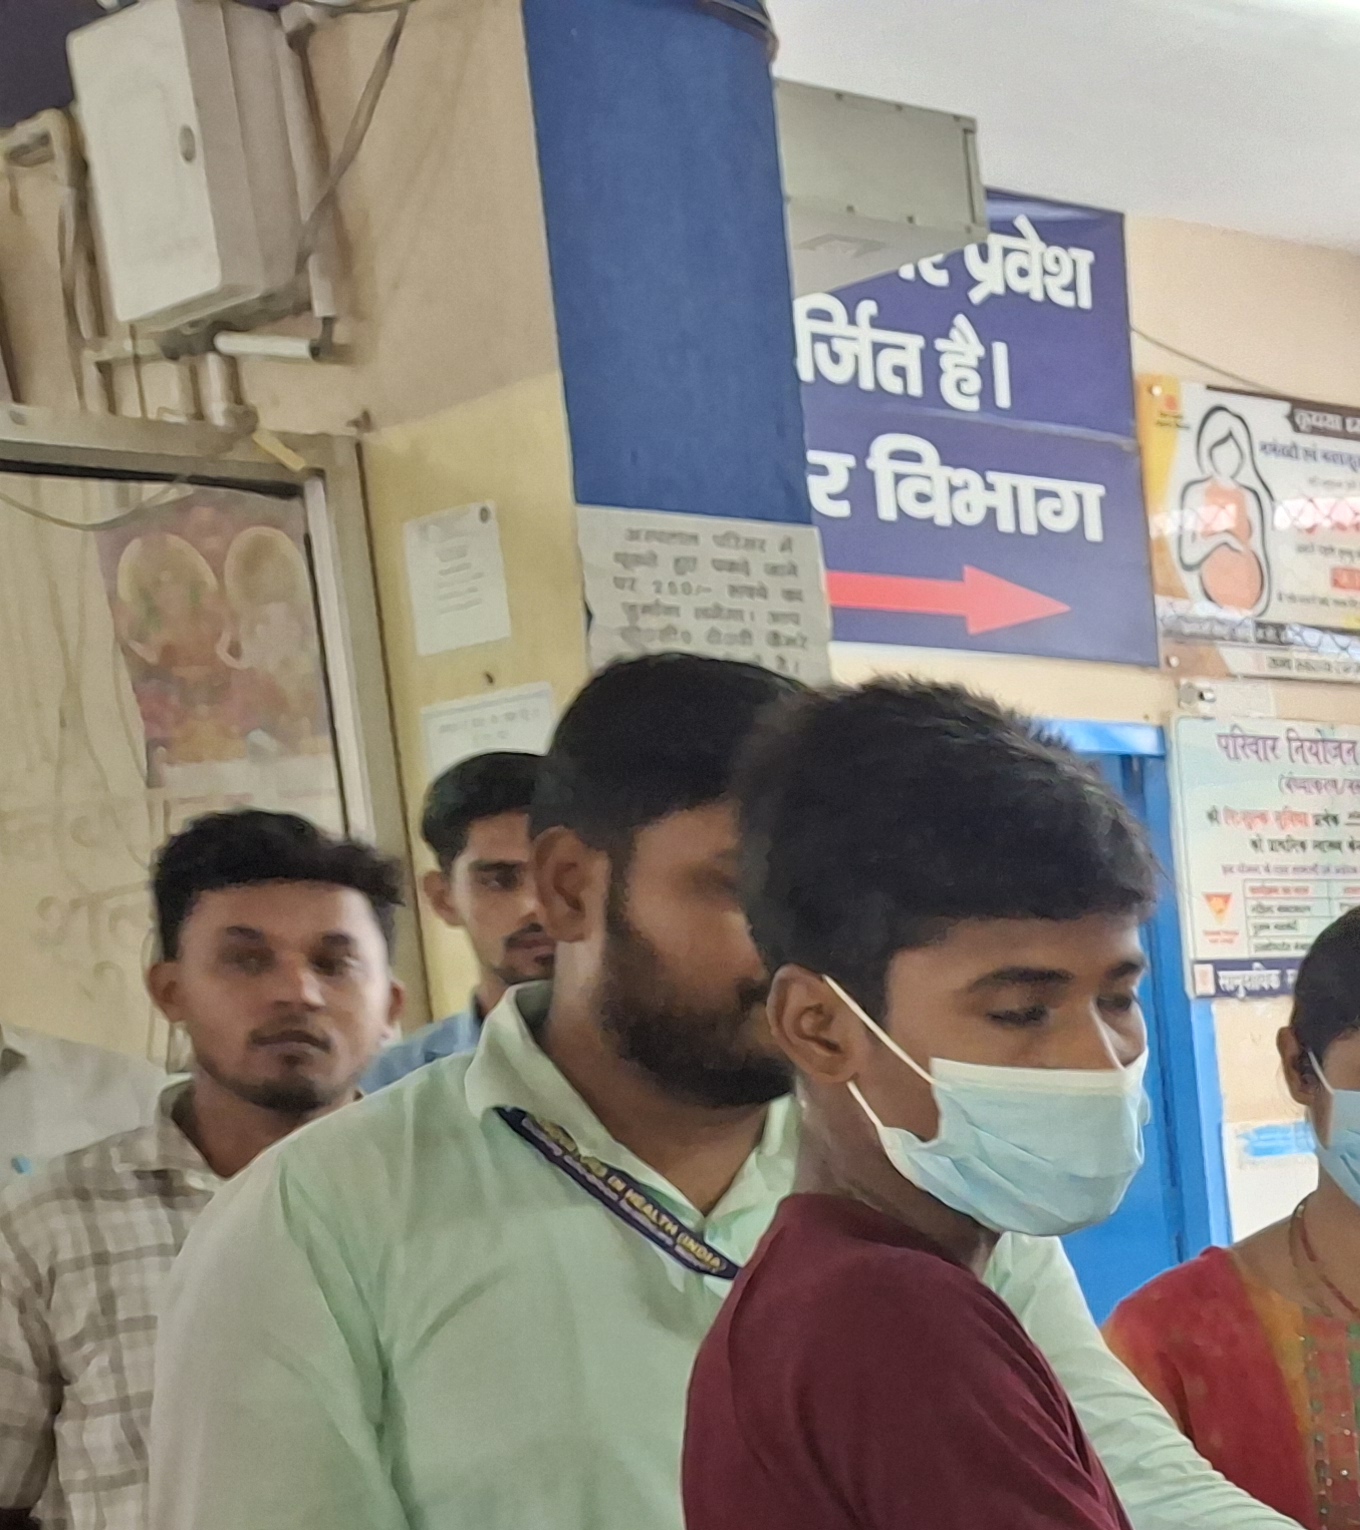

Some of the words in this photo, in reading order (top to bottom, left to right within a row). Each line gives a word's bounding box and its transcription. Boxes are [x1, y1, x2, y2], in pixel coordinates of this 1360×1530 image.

[964, 214, 1094, 309] प्रवेश
[793, 292, 925, 398] र्जित
[806, 449, 855, 518] र
[866, 433, 1106, 542] विभाग
[1216, 725, 1279, 761] परिवार
[1286, 728, 1358, 766] नियोजन
[625, 1188, 679, 1236] HEALTH
